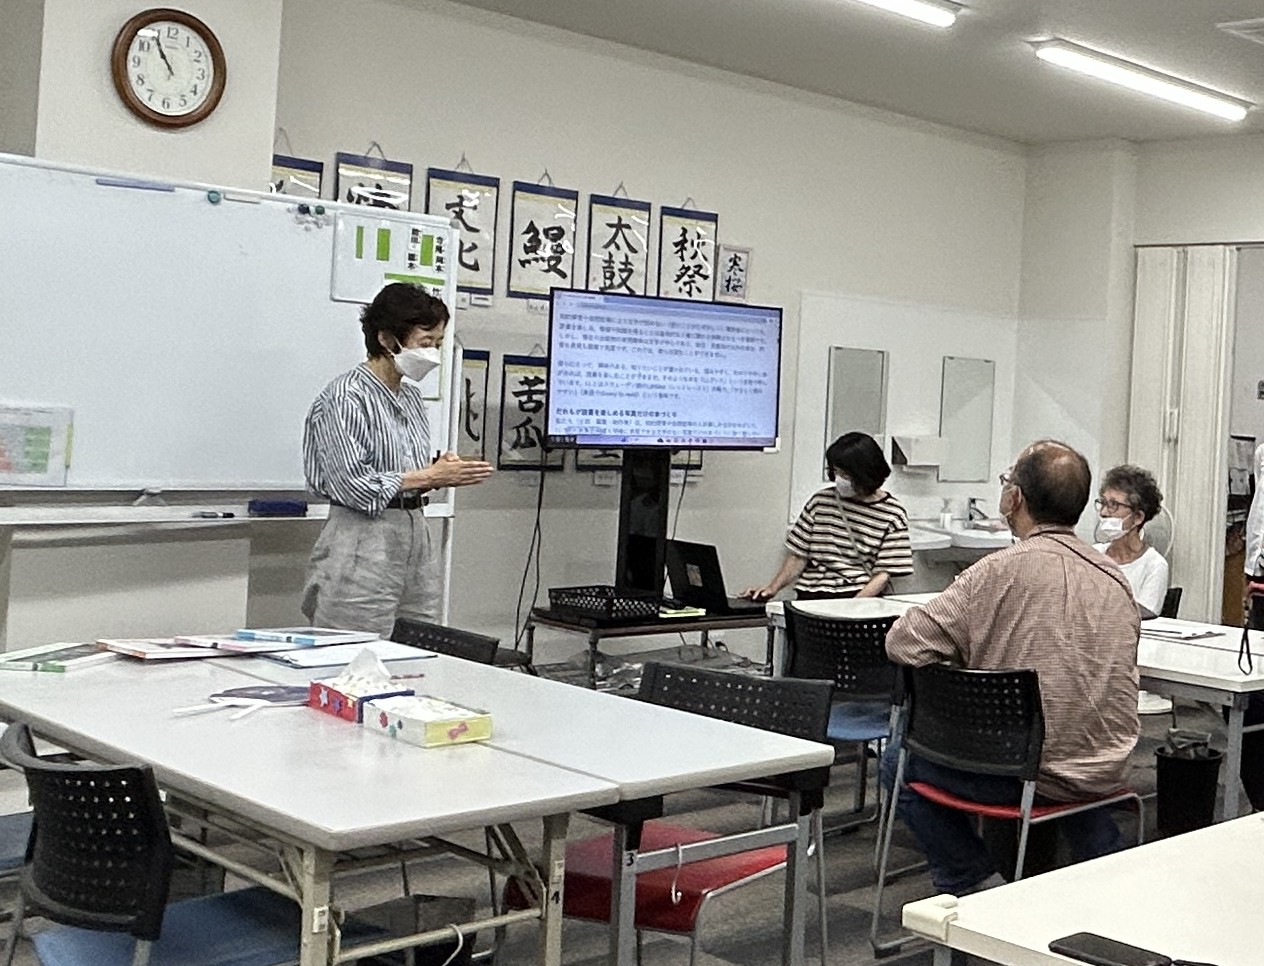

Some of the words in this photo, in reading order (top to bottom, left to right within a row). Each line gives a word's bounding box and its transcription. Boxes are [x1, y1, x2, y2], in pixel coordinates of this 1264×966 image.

[167, 27, 179, 40] 12
[139, 39, 151, 52] 10
[186, 36, 190, 48] 1
[132, 55, 140, 68] 9
[194, 49, 202, 63] 2
[136, 74, 145, 87] 8
[196, 68, 205, 81] 3
[146, 88, 154, 102] 7
[190, 84, 198, 97] 4
[162, 97, 170, 110] 6
[179, 94, 188, 107] 5
[517, 219, 568, 280] 鰻
[600, 215, 638, 295] 太鼓
[672, 226, 710, 298] 秋祭
[511, 375, 553, 453] 苦瓜
[626, 852, 634, 867] 3
